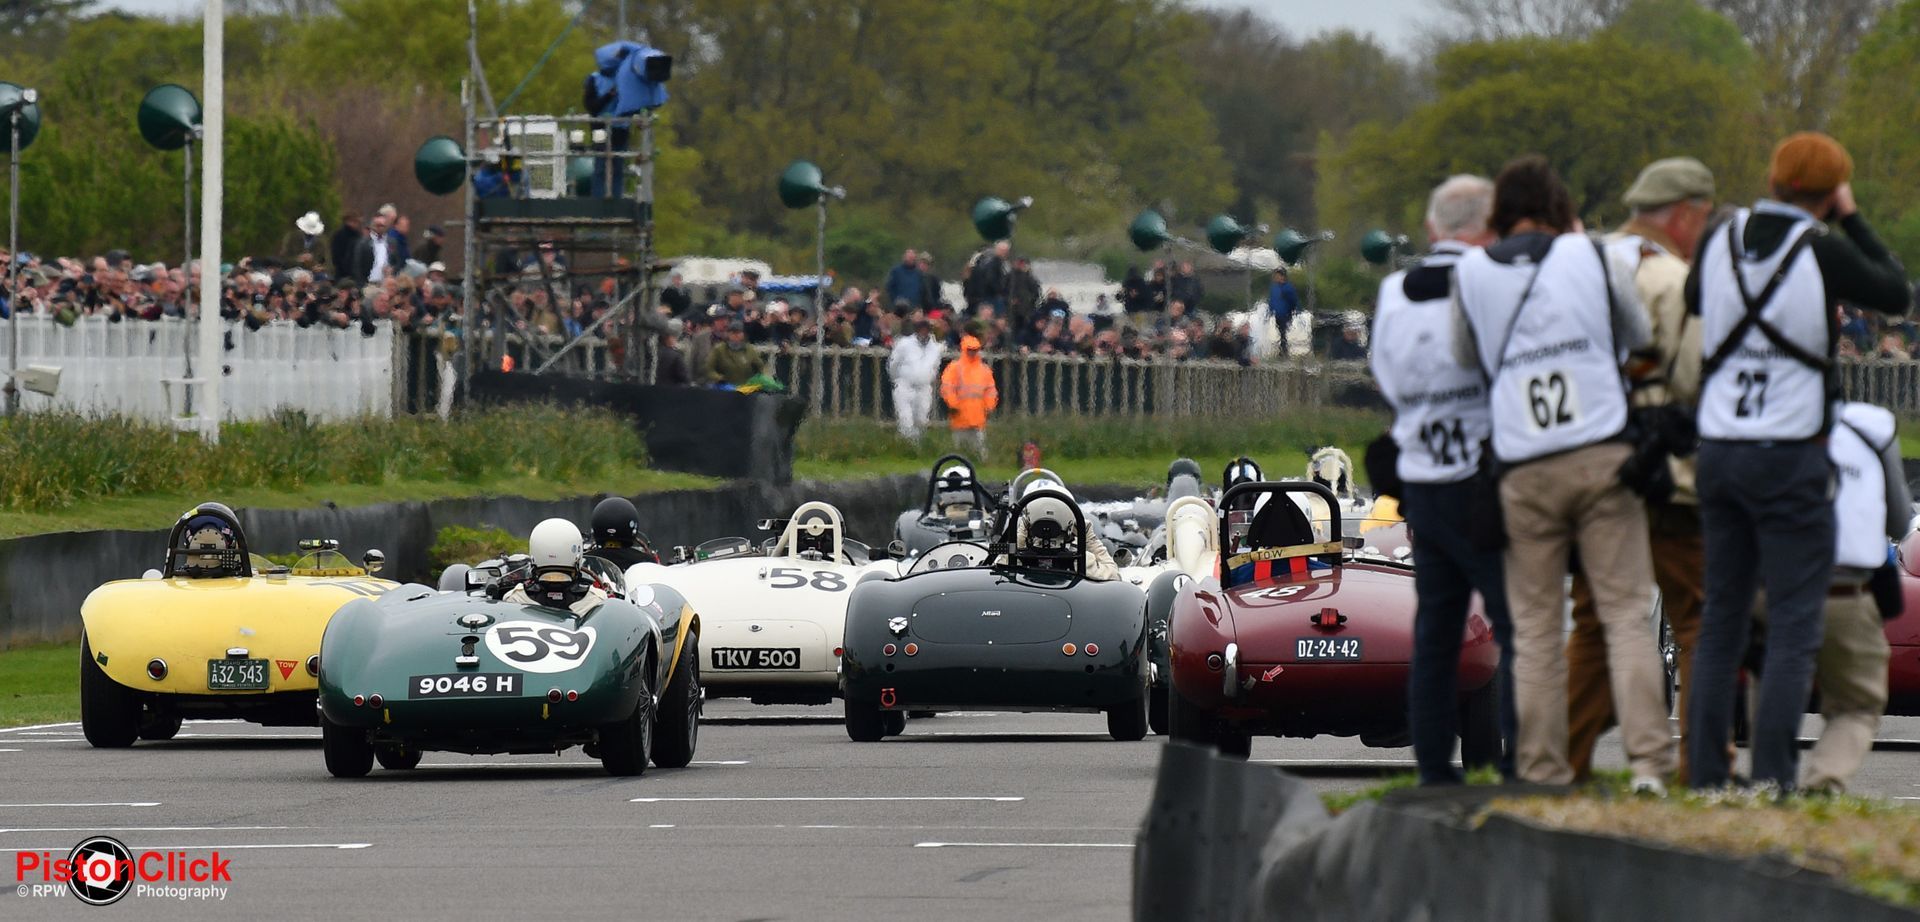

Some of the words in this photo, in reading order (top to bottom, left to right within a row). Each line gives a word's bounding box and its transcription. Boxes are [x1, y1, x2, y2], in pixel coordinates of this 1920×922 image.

[1529, 371, 1574, 429] 62
[1736, 371, 1768, 418] 27
[1420, 417, 1471, 466] 121
[1257, 549, 1284, 561] TOW
[770, 567, 848, 592] 58
[496, 627, 590, 662] 59
[1298, 639, 1358, 657] DZ-24-42
[714, 650, 752, 667] TKV
[758, 650, 797, 667] 500
[219, 665, 235, 683] 32
[239, 665, 263, 683] 543
[419, 676, 488, 694] 9046
[496, 676, 513, 692] H
